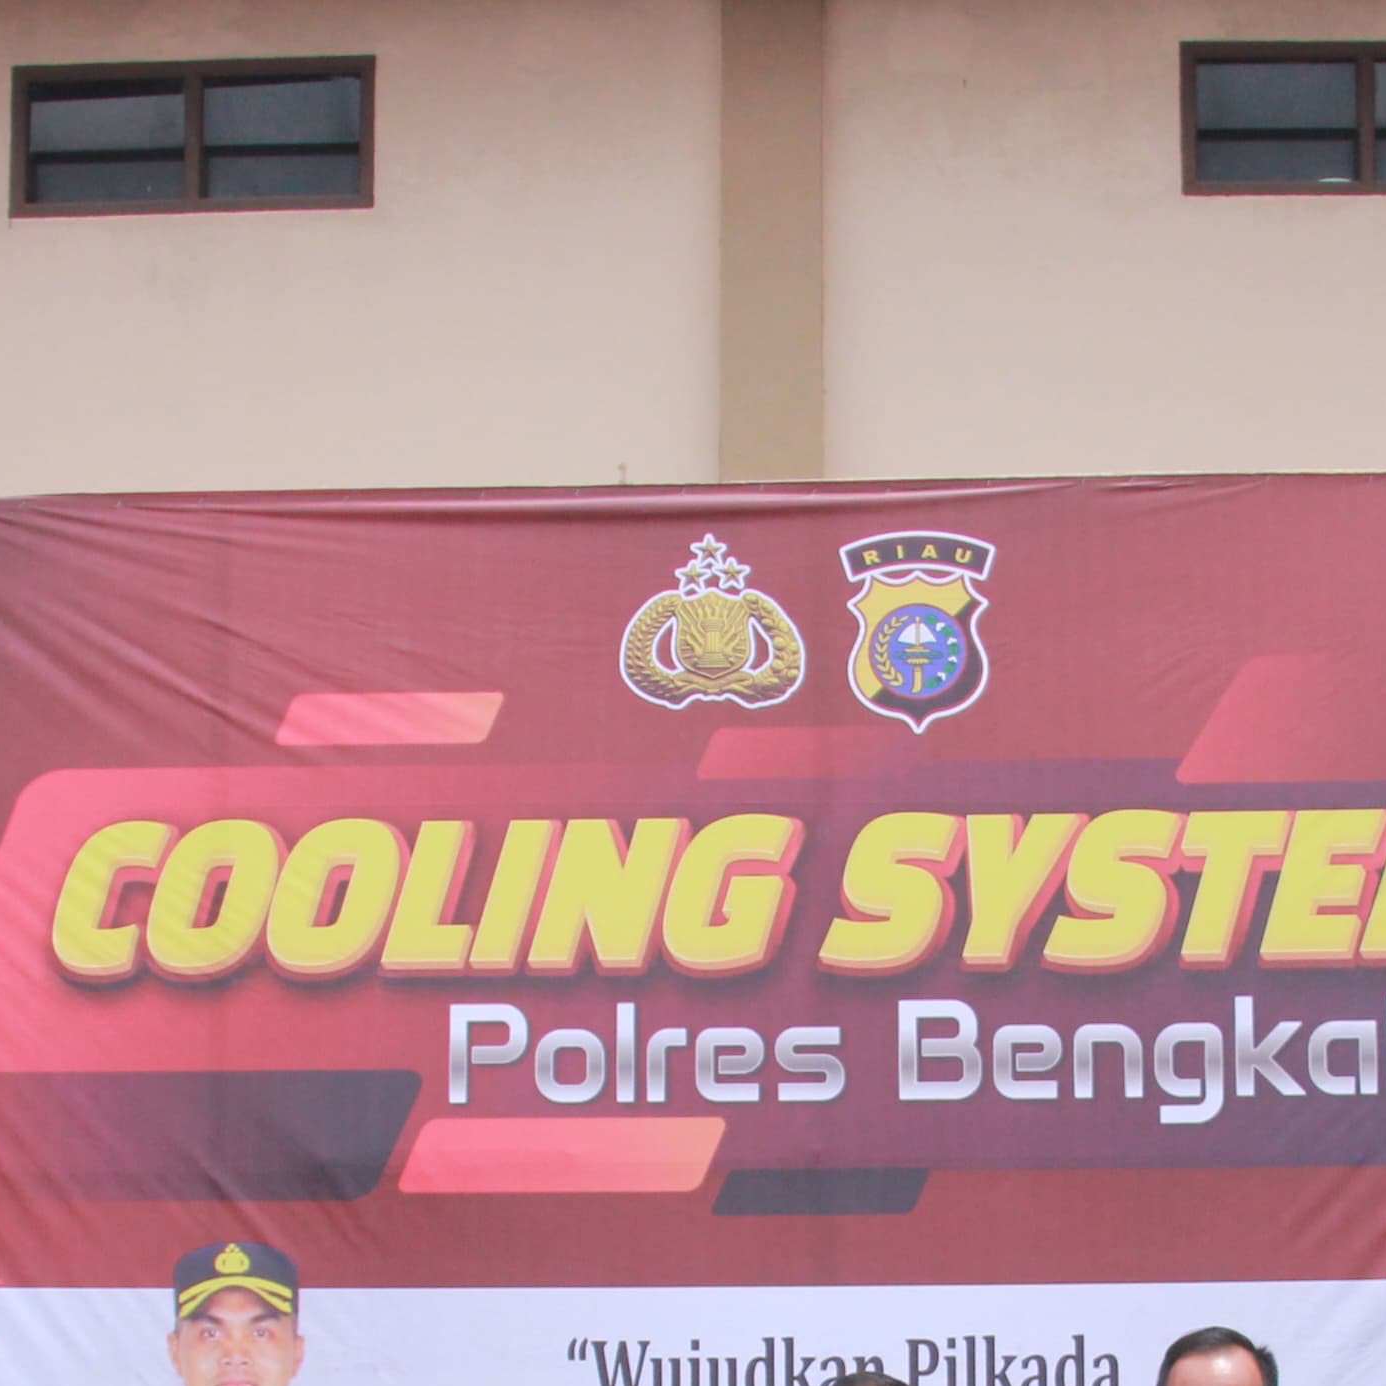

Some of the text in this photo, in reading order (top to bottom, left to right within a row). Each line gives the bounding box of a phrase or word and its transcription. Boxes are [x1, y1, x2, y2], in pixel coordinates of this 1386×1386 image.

[863, 543, 974, 566] RIAU
[51, 813, 803, 978] COOLING
[448, 1001, 846, 1104] Polres
